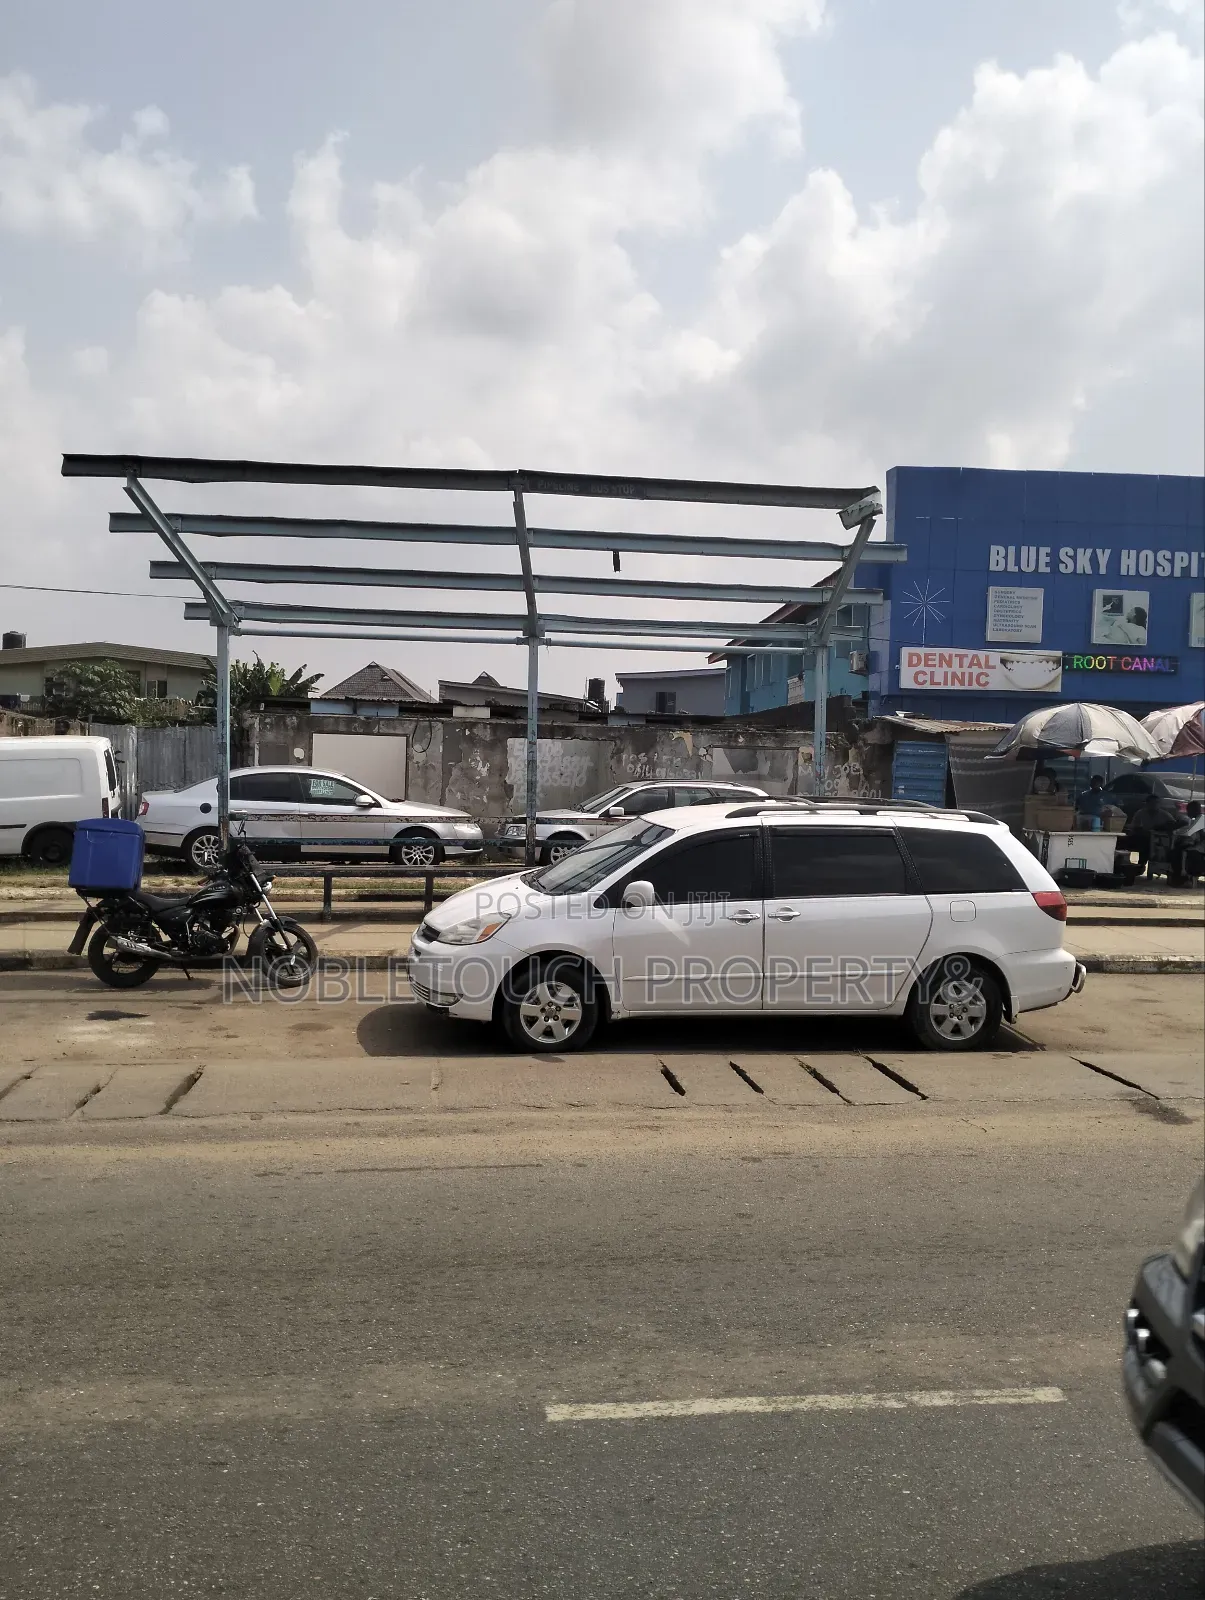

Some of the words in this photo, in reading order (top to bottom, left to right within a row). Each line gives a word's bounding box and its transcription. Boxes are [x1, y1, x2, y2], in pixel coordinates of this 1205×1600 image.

[591, 483, 609, 494] BUS
[989, 545, 1051, 573] BLUE
[1058, 546, 1112, 574] SKY
[1120, 549, 1205, 578] HOSPI
[907, 652, 997, 670] DENTAL
[1073, 655, 1117, 670] ROOT
[1121, 656, 1175, 672] CANAL
[913, 670, 991, 688] CLINIC
